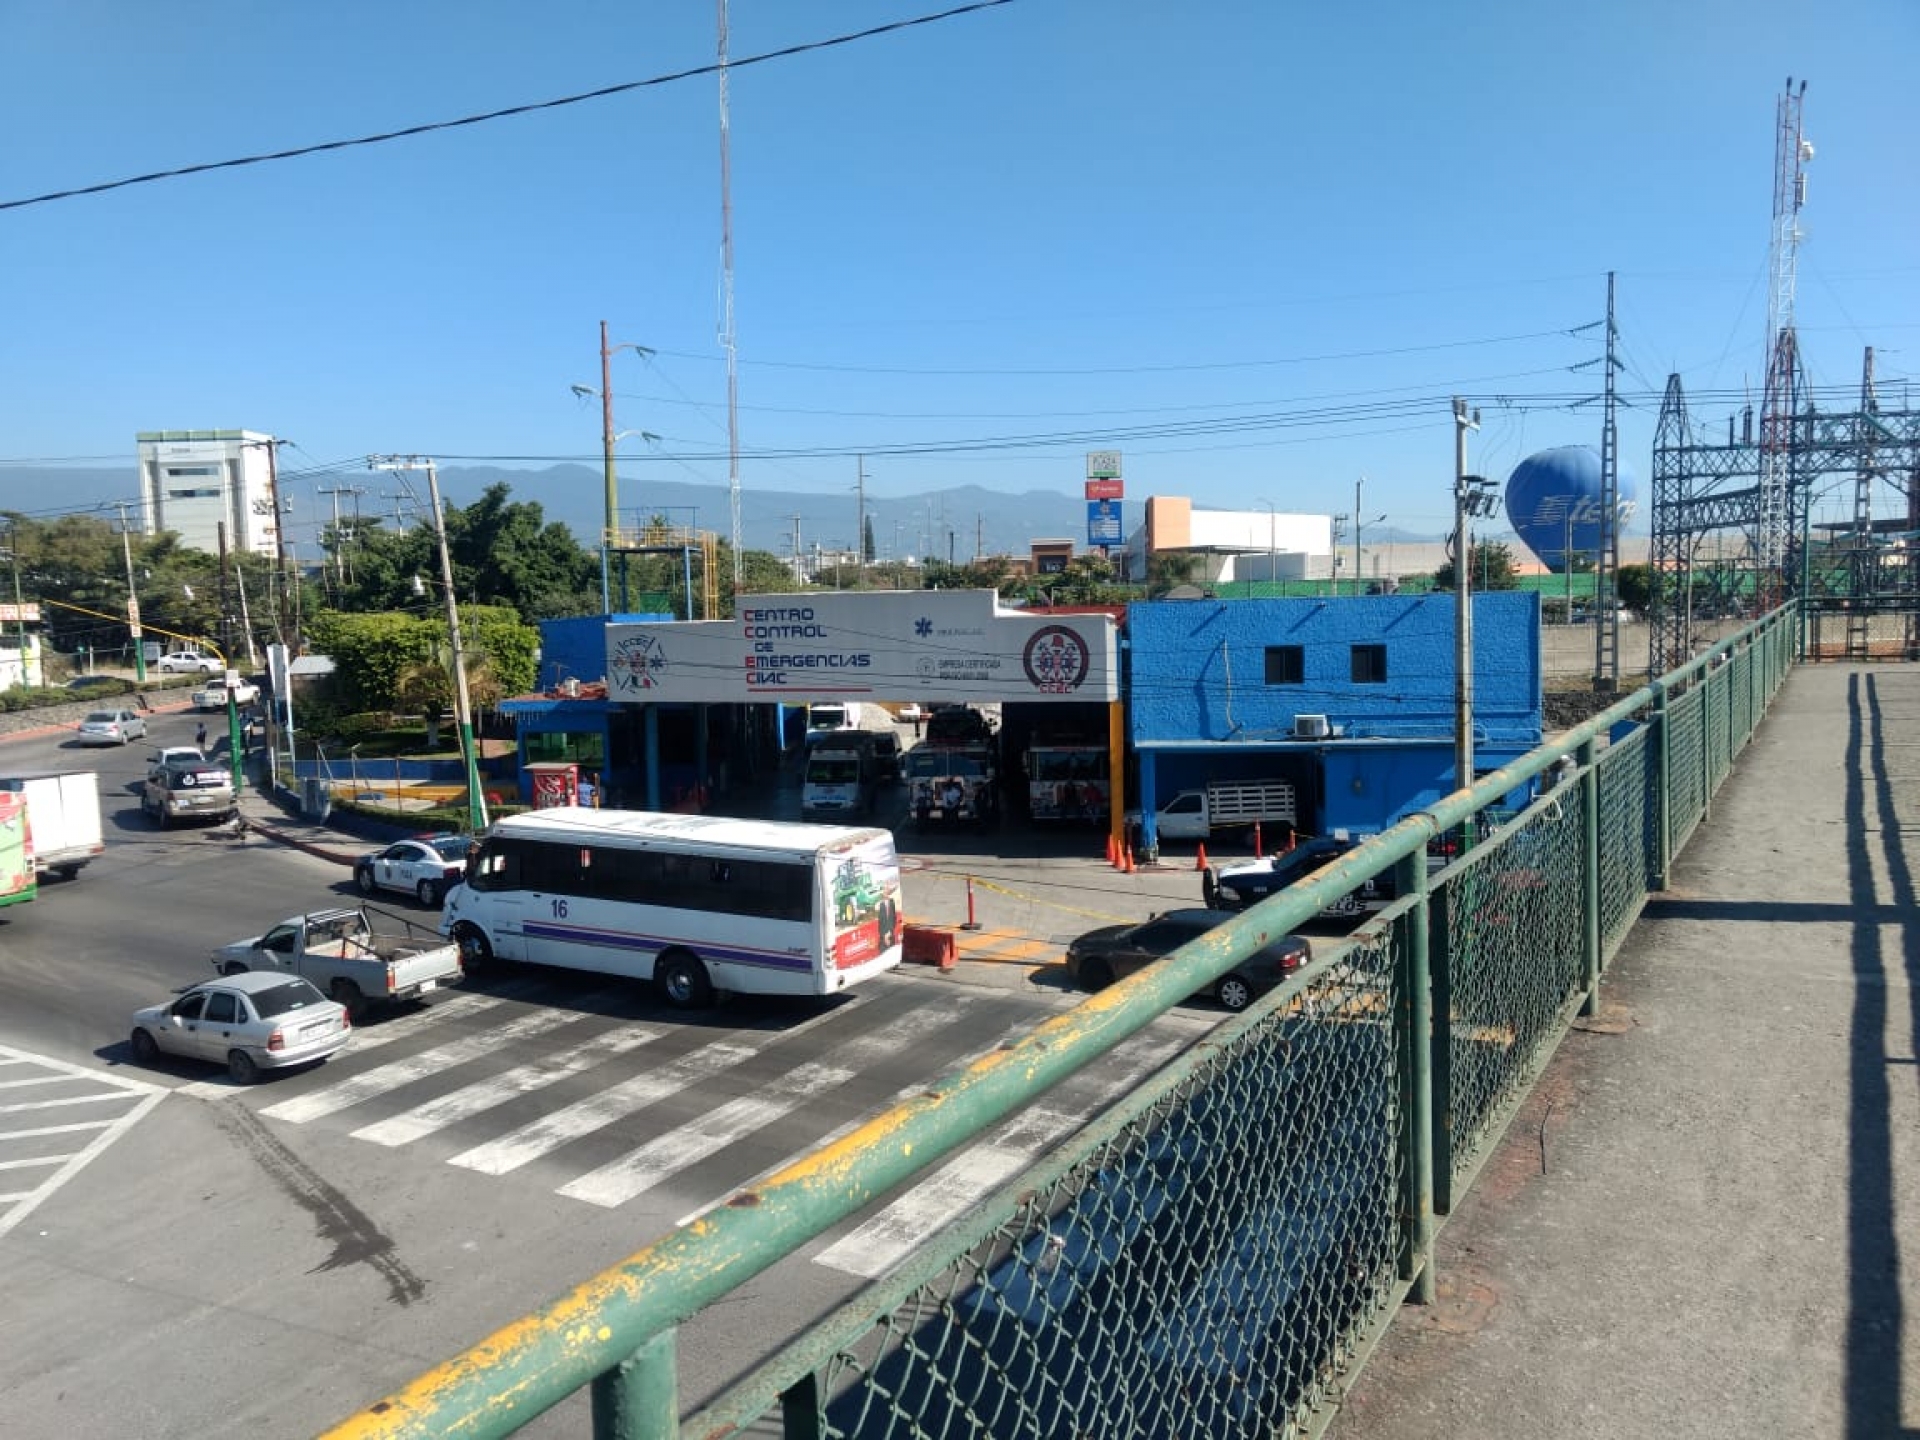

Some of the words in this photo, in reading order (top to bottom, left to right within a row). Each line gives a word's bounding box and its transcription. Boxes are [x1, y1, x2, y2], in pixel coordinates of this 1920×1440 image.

[744, 608, 814, 621] CENTRO
[744, 625, 828, 639] CONTROL
[754, 641, 774, 653] DE
[745, 654, 871, 668] EMERGENCIAS
[551, 899, 568, 918] 16
